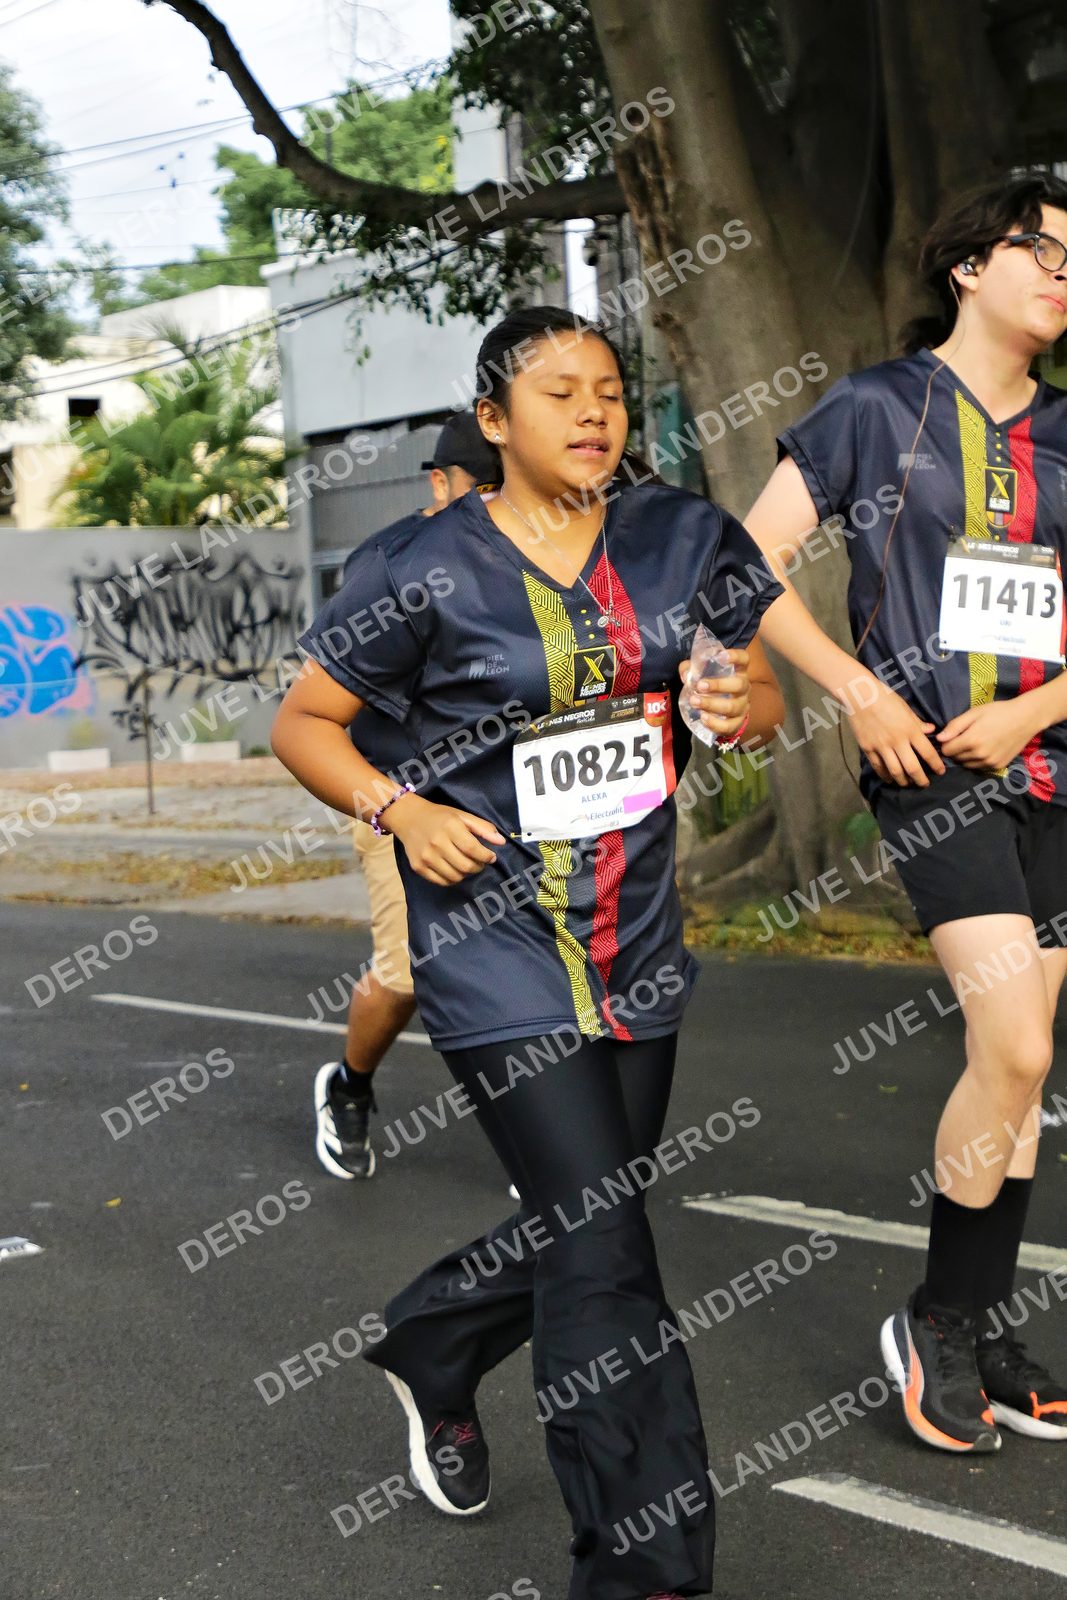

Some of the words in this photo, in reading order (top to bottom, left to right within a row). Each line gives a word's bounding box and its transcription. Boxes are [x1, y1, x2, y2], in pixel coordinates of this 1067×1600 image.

[954, 573, 1057, 618] 11413
[581, 682, 607, 692] LENES
[537, 716, 563, 730] LENES
[563, 709, 596, 722] NEGROS
[523, 733, 652, 796] 10825
[581, 792, 608, 804] ALEXA
